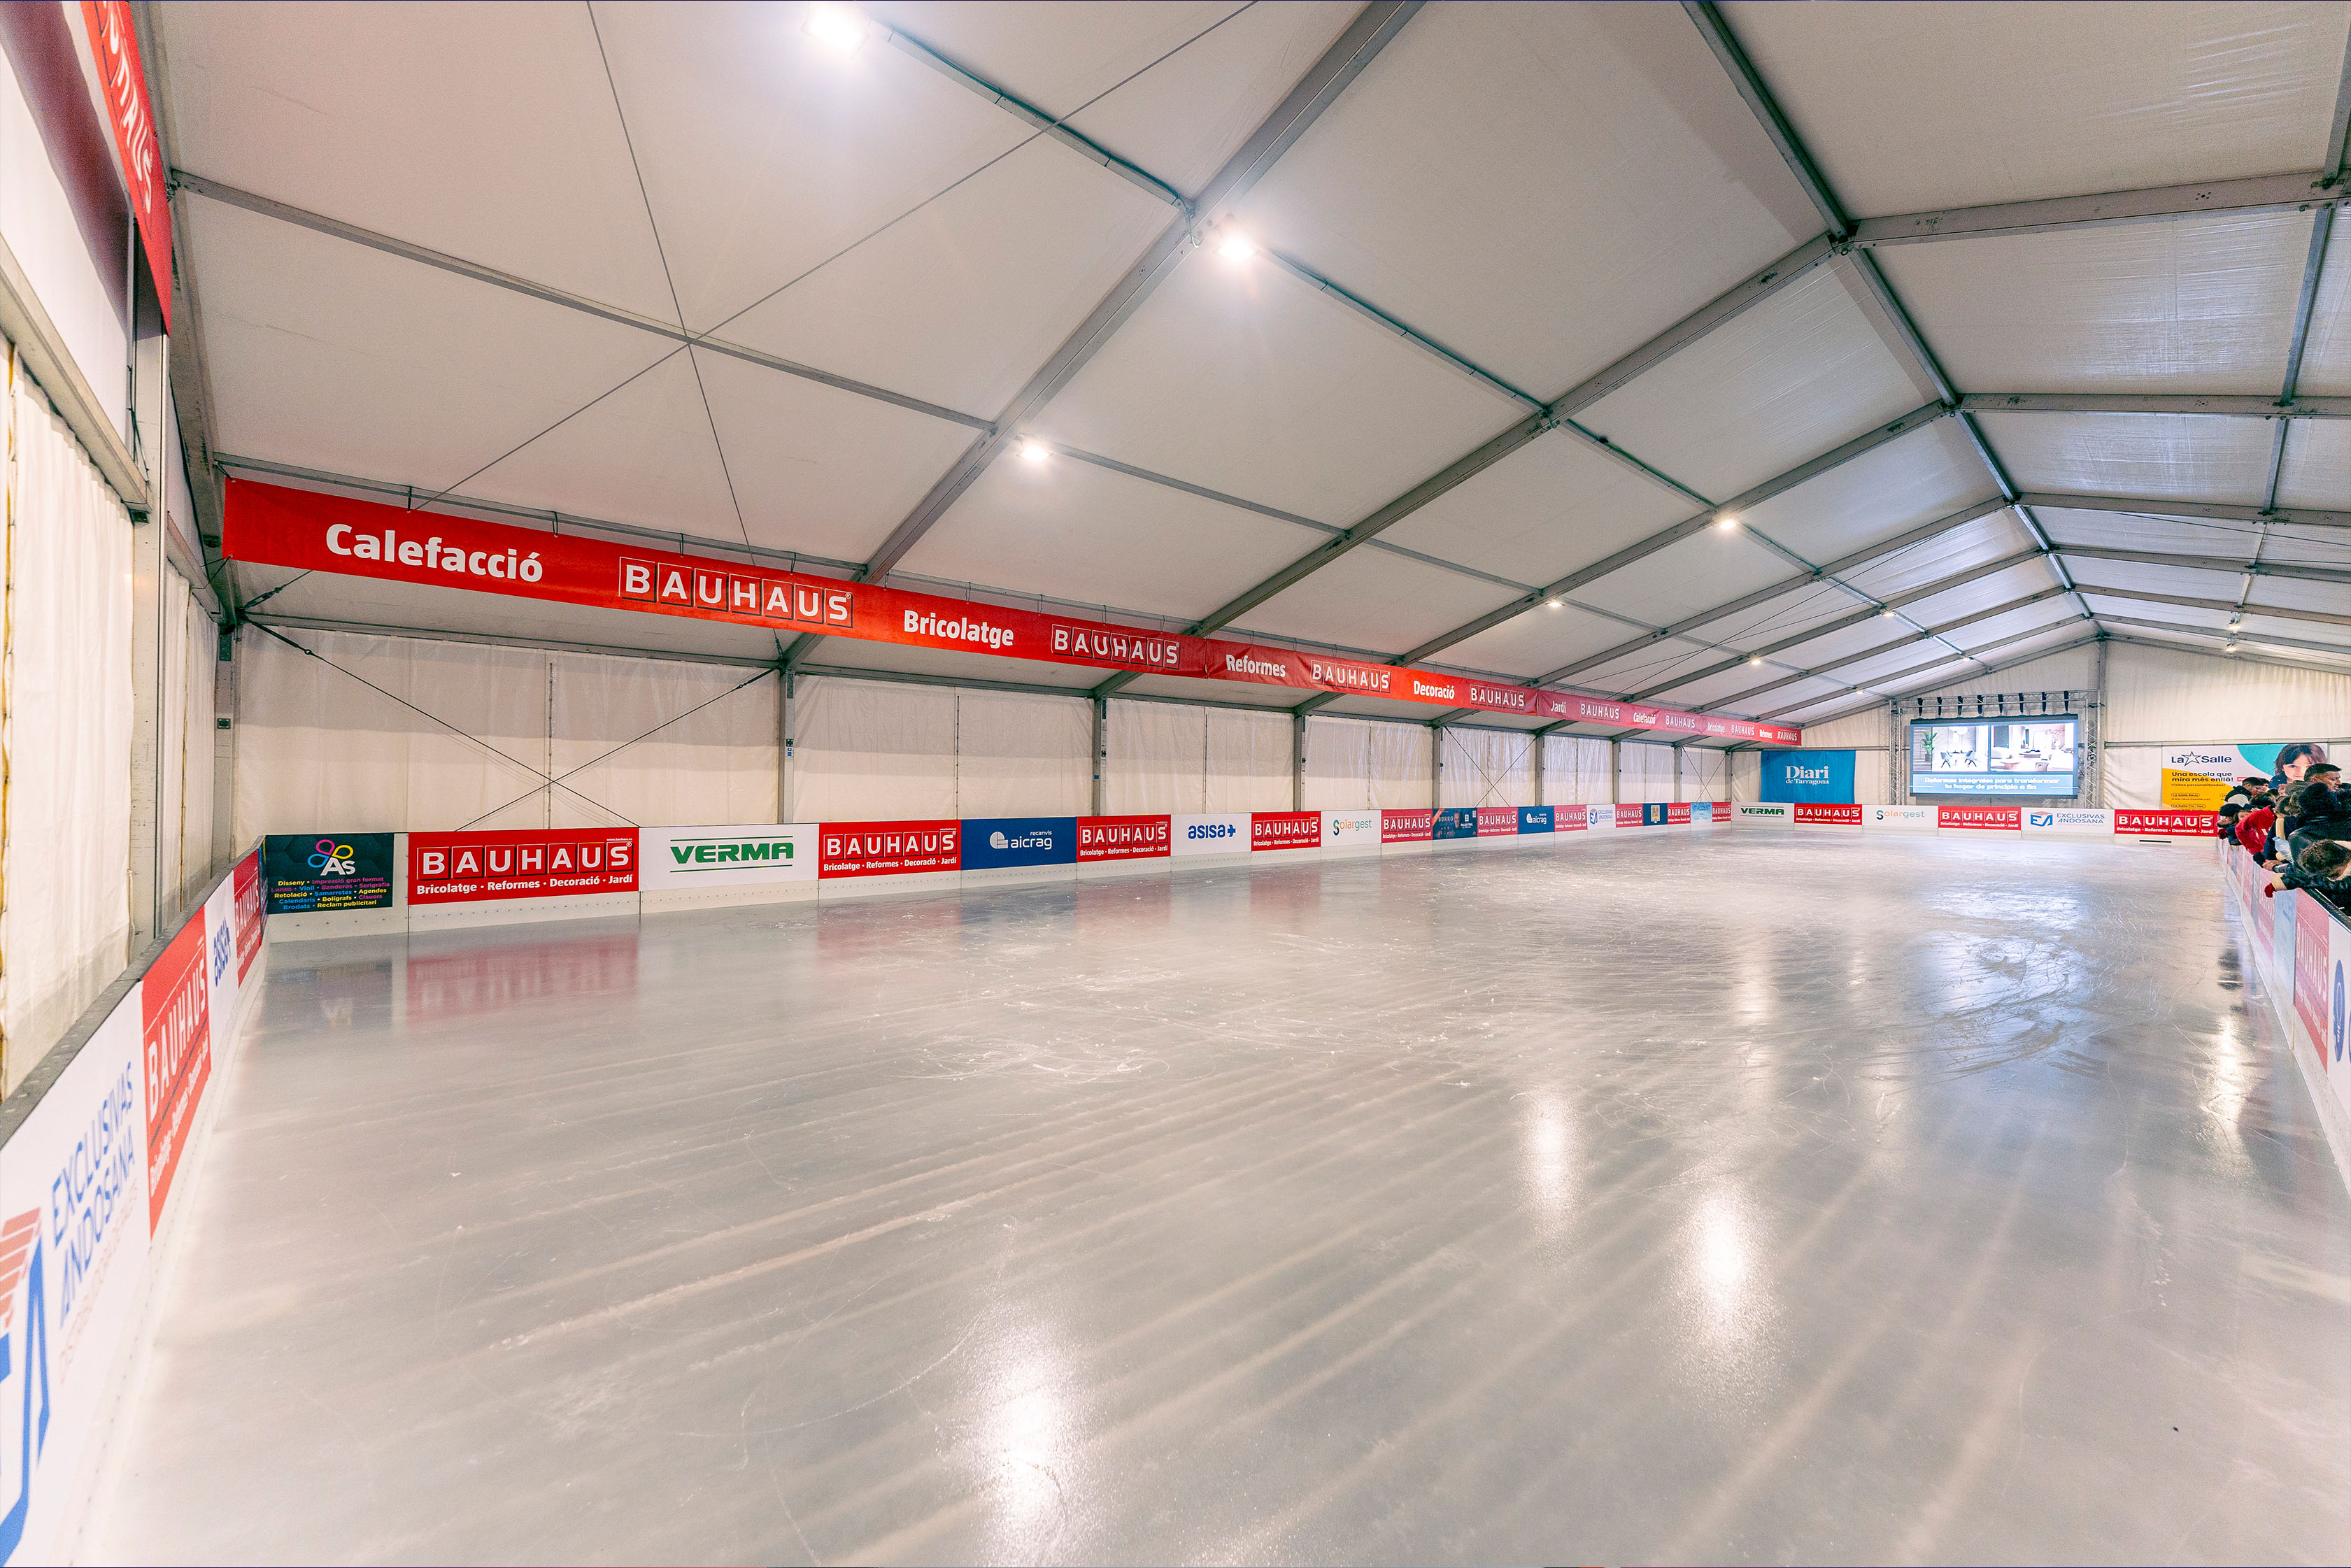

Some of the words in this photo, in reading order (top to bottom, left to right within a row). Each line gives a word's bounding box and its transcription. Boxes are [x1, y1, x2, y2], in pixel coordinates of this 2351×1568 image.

[326, 523, 543, 583] Calefacció
[625, 564, 848, 621] BAUHAUS
[904, 610, 1014, 649] Bricolatge
[1053, 629, 1178, 664] BAUHAUS
[1226, 654, 1286, 678] Reformes
[1312, 662, 1390, 690] BAUHAUS
[1414, 680, 1455, 700] Decoració
[1470, 687, 1525, 707] BAUHAUS
[1550, 700, 1567, 713] Jardí
[1581, 704, 1619, 719] BAUHAUS
[1665, 715, 1696, 729] BAUHAUS
[1731, 723, 1754, 736] BAUHAUS
[1777, 731, 1798, 741] BAUHAUS
[1785, 766, 1830, 779] Diari
[1556, 812, 1586, 821] BAUHAUS
[1617, 810, 1642, 818] BAUHAUS
[1740, 807, 1784, 815] VERMA
[1797, 808, 1859, 817] BAUHAUS
[1876, 809, 1925, 820] Solargest
[1942, 811, 2017, 822] BAUHAUS
[1333, 818, 1372, 836] Solargest
[1384, 818, 1430, 829] BAUHAUS
[1479, 814, 1517, 825] BAUHAUS
[2119, 816, 2212, 827] BAUHAUS
[1082, 826, 1166, 844] BAUHAUS
[1255, 821, 1318, 836] BAUHAUS
[827, 834, 954, 856] BAUHAUS
[1011, 835, 1053, 850] aicrag
[422, 846, 630, 875] BAUHAUS
[670, 842, 794, 864] VERMA
[320, 856, 356, 876] As
[823, 863, 860, 871] Bricolatge
[904, 857, 936, 867] Decoració
[941, 856, 957, 864] Jardí
[417, 884, 477, 895] Bricolatge
[487, 881, 541, 891] Reformes
[549, 876, 600, 888] Decoració
[608, 874, 633, 885] Jardí
[148, 957, 207, 1123] BAUHAUS
[52, 1062, 134, 1250] EXCLUSIVAS
[59, 1125, 136, 1331] ANDOSANA
